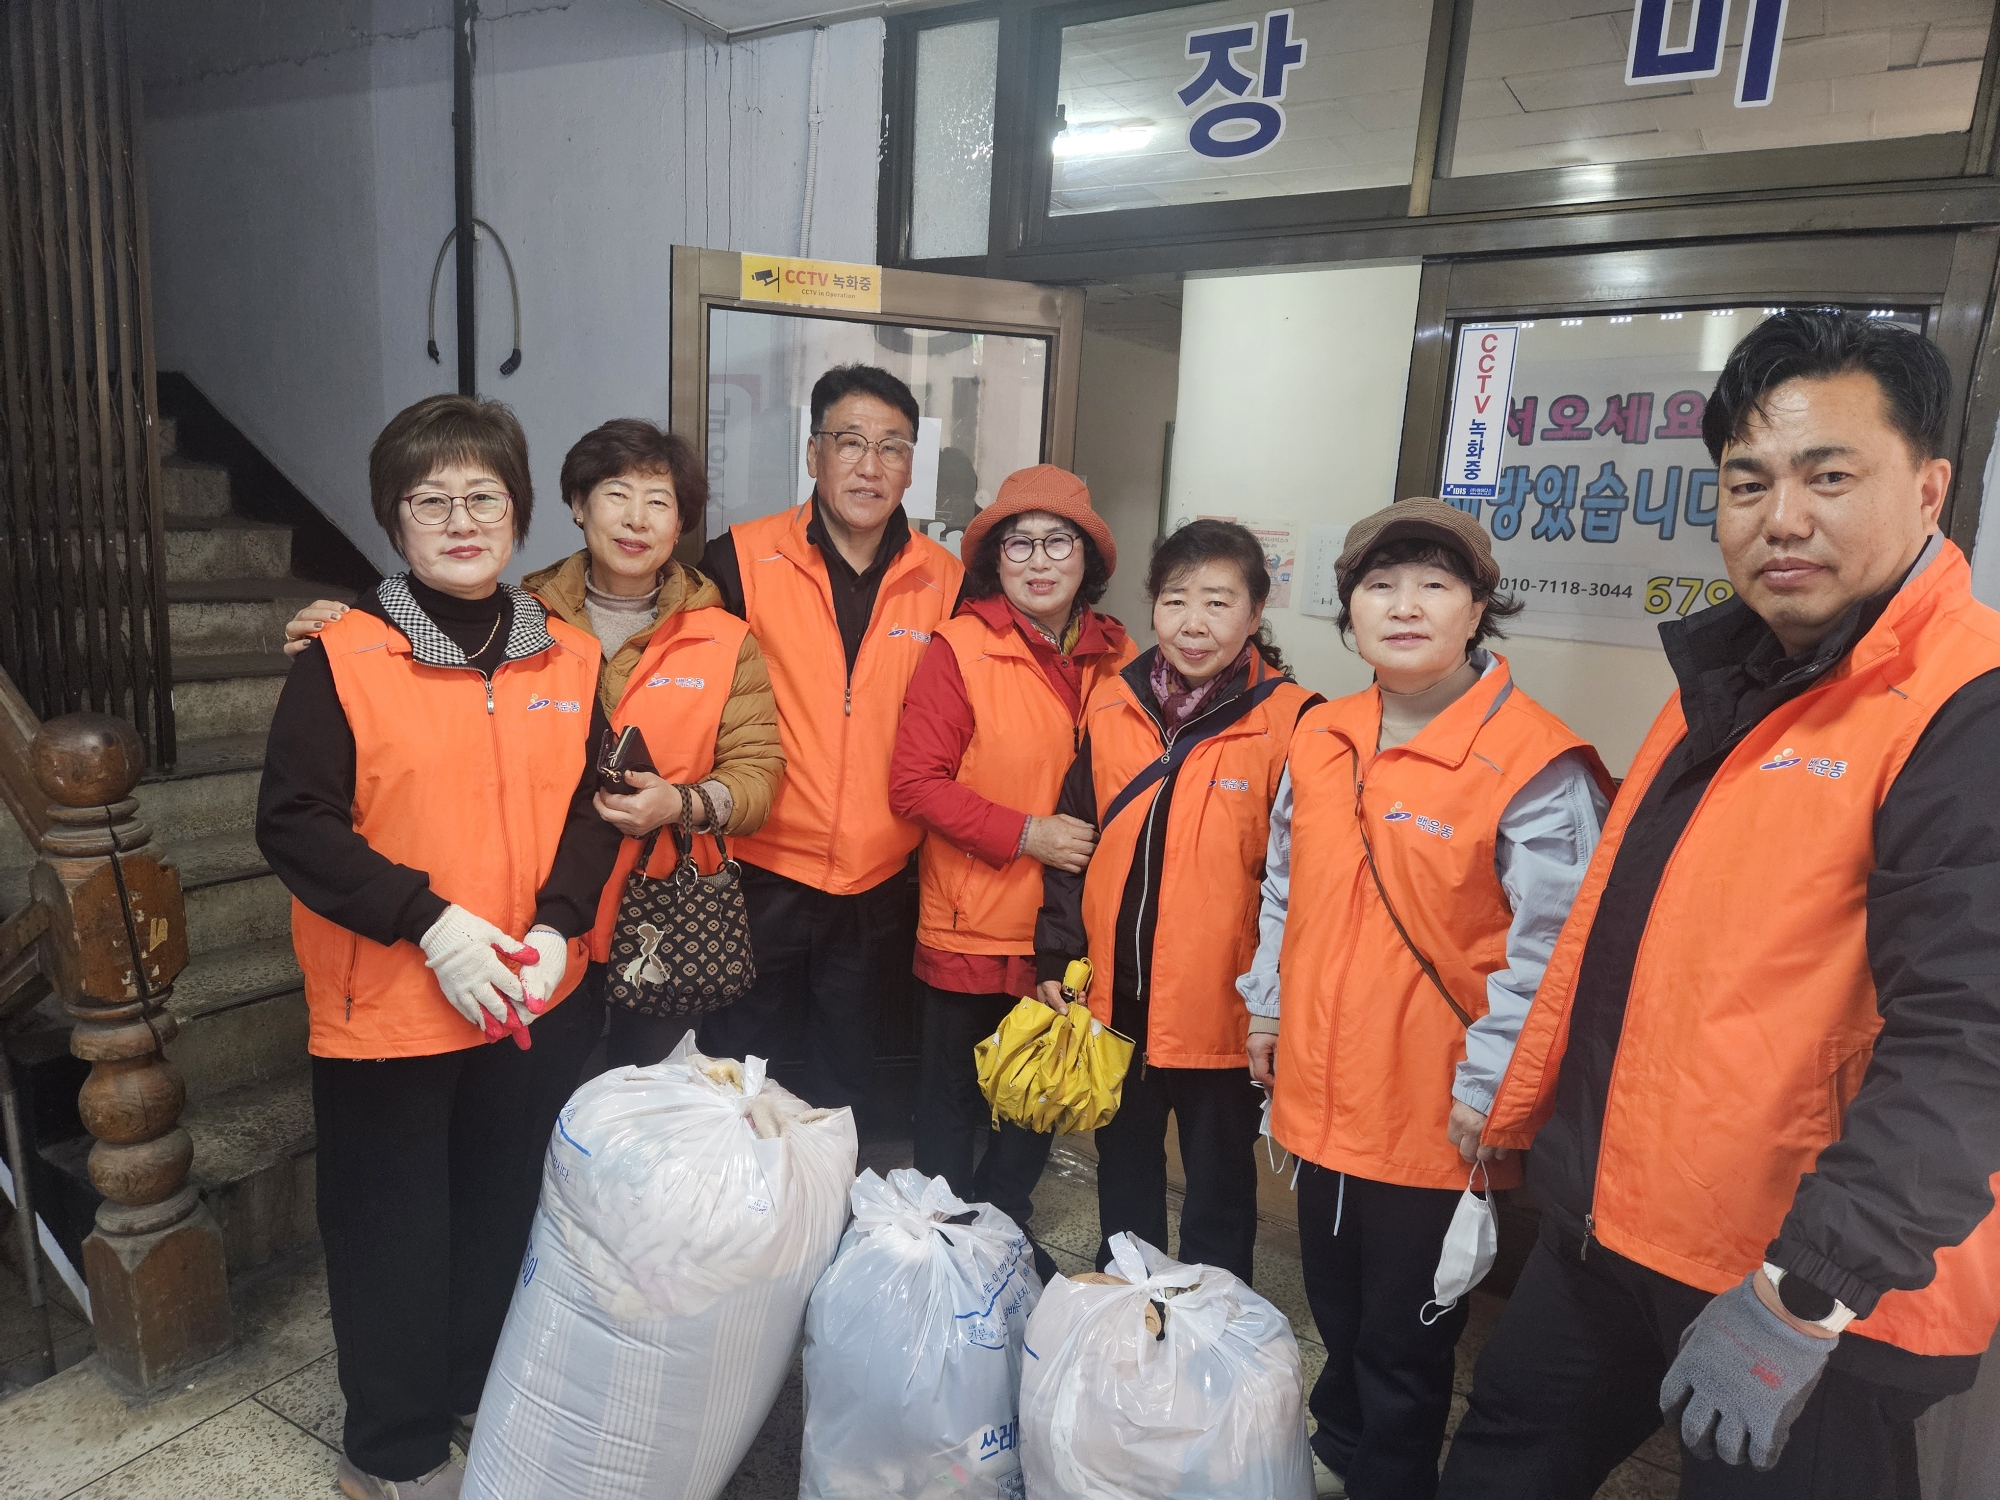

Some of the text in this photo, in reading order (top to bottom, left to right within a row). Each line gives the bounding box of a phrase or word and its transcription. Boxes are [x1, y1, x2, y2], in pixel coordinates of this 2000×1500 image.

[1174, 0, 1789, 162] 장 미
[784, 269, 872, 292] CCTV 녹화중
[801, 288, 817, 296] CCTV
[825, 291, 856, 299] Operation
[1474, 333, 1498, 414] CCTV
[1506, 390, 1709, 446] 서오세요
[1463, 418, 1487, 481] 녹화중
[1452, 487, 1467, 495] IDIS
[1499, 577, 1633, 599] 010-7118-3044
[1806, 757, 1848, 779] 백운동
[1416, 815, 1454, 839] 백운동
[980, 1414, 1019, 1461] 쓰레
